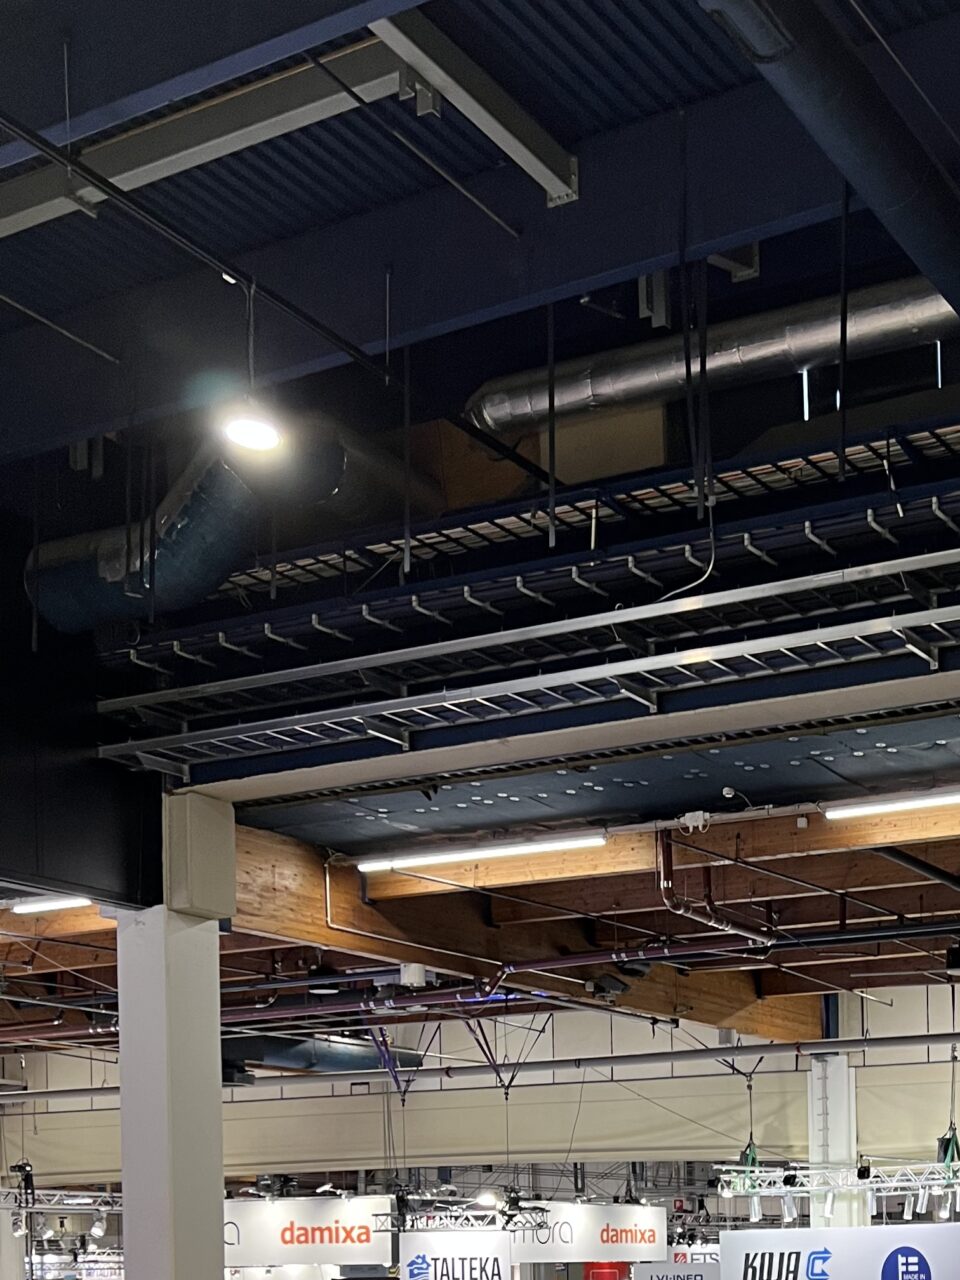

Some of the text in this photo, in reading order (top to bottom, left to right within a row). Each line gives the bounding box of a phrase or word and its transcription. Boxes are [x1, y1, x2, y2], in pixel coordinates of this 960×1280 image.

[280, 1220, 371, 1245] damixa
[600, 1223, 656, 1244] damixa
[431, 1257, 502, 1280] TALTEKA
